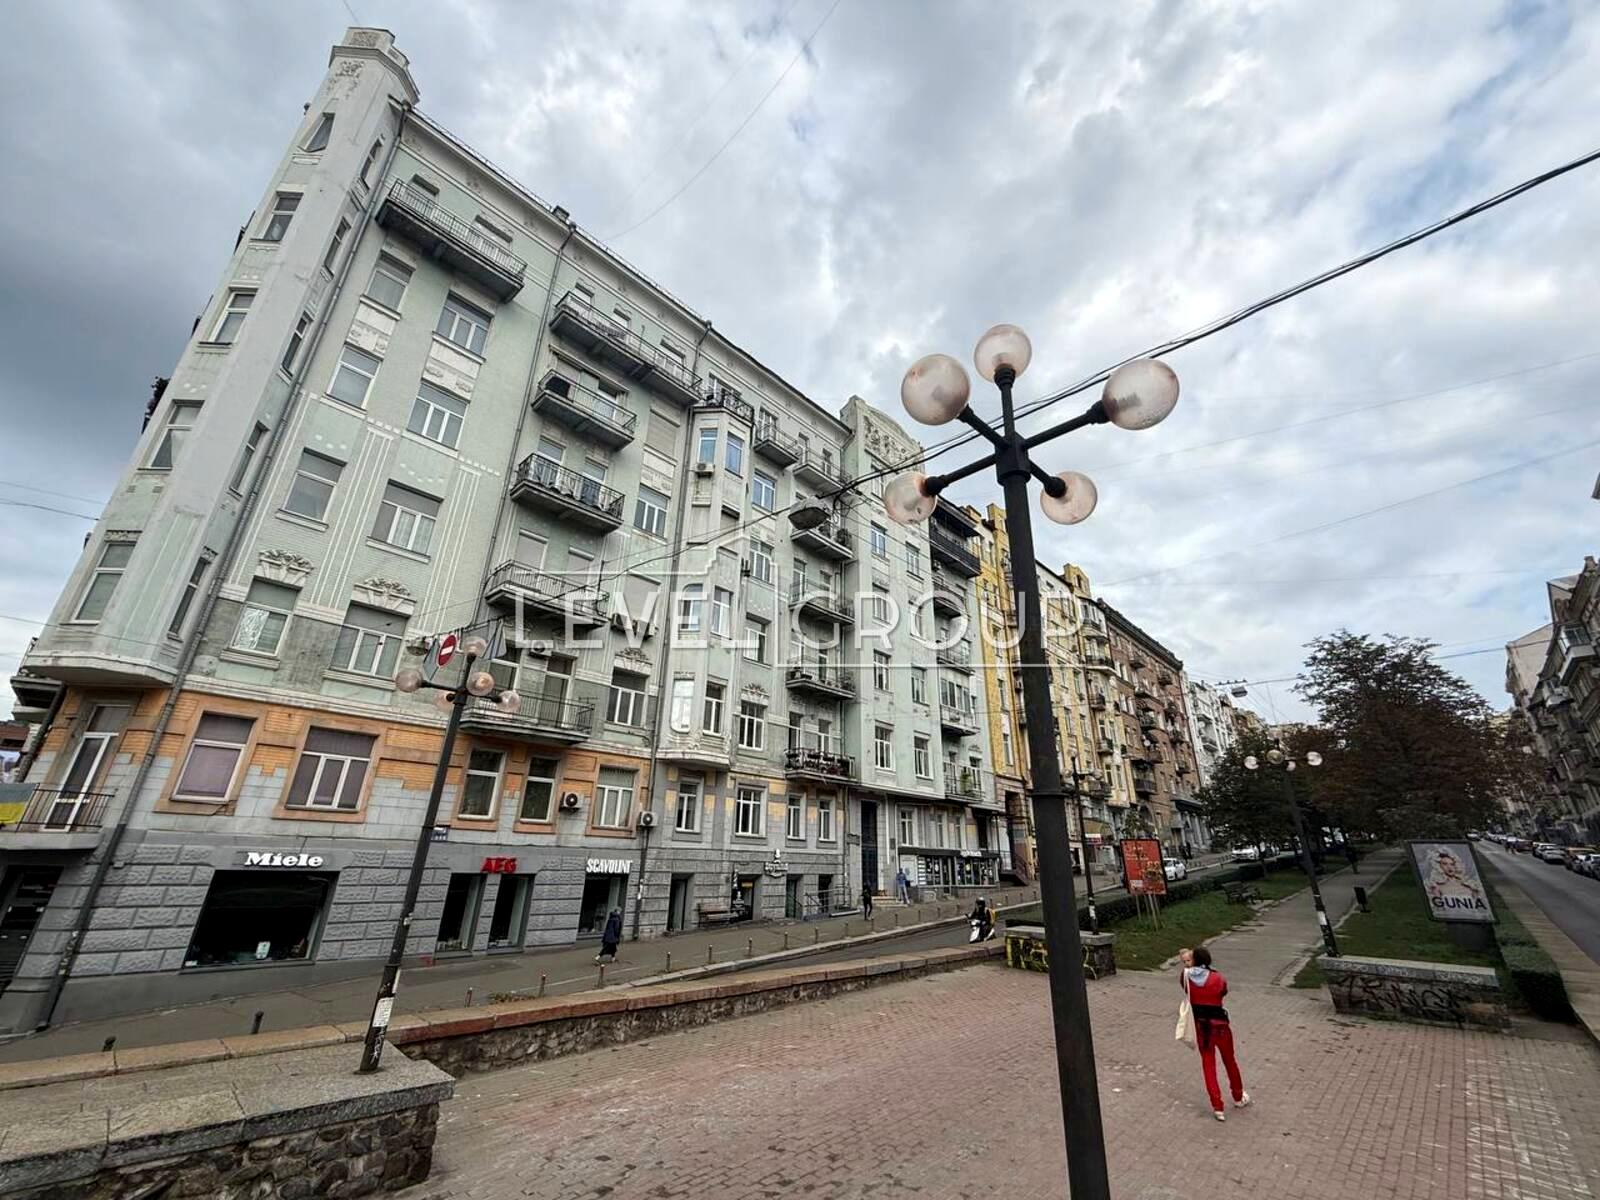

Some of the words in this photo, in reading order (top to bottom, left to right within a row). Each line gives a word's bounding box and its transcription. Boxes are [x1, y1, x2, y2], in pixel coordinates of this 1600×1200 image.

[244, 852, 324, 867] Miele
[481, 857, 518, 873] AEG
[1431, 896, 1487, 910] GUNIA
